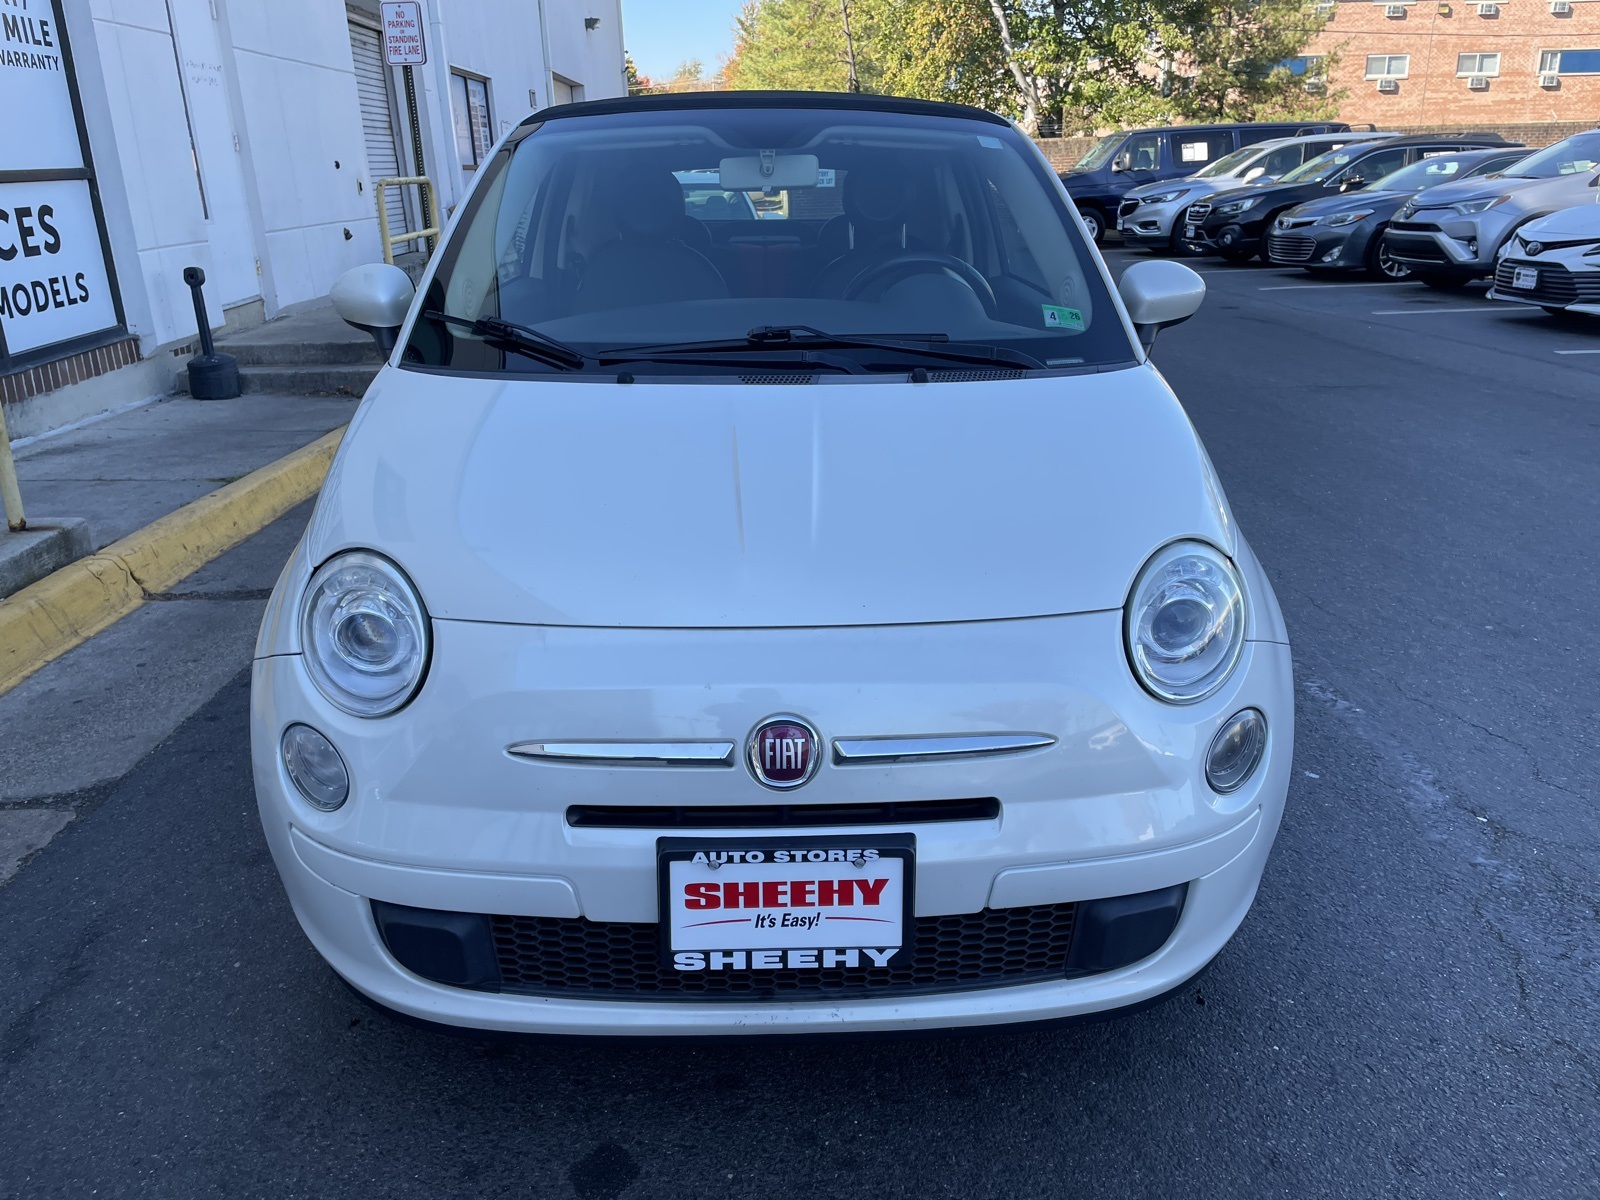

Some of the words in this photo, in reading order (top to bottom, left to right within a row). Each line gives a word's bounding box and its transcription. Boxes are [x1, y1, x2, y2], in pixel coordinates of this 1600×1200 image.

[395, 11, 405, 19] NO
[2, 13, 53, 47] MILE
[387, 20, 415, 28] PARKING
[388, 35, 419, 44] STANDING
[389, 46, 403, 55] FIRE
[404, 45, 420, 55] LANE
[0, 272, 90, 319] MODELS
[1050, 311, 1056, 321] 4
[1069, 312, 1081, 321] 26
[765, 738, 806, 770] FIAT
[691, 851, 765, 864] AUTO
[773, 849, 880, 863] STORES
[684, 878, 890, 910] SHEEHY
[754, 913, 777, 929] It's
[780, 912, 821, 930] Easy!
[673, 948, 900, 971] SHEEHY
